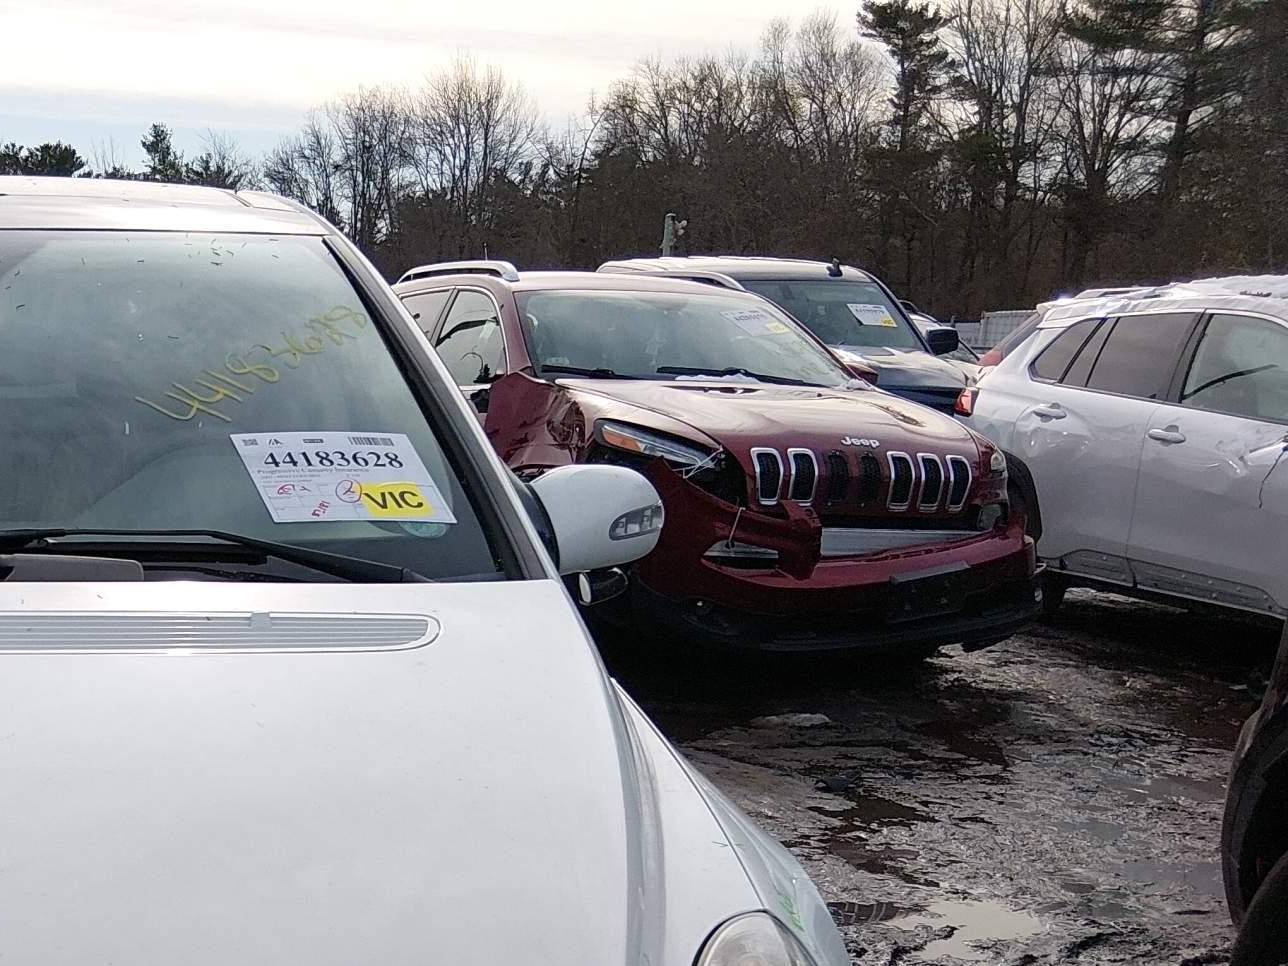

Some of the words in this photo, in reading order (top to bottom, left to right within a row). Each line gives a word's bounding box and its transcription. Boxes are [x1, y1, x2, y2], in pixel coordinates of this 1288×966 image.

[840, 436, 880, 449] Jeep
[264, 451, 404, 469] 44183628
[362, 490, 424, 510] VIC
